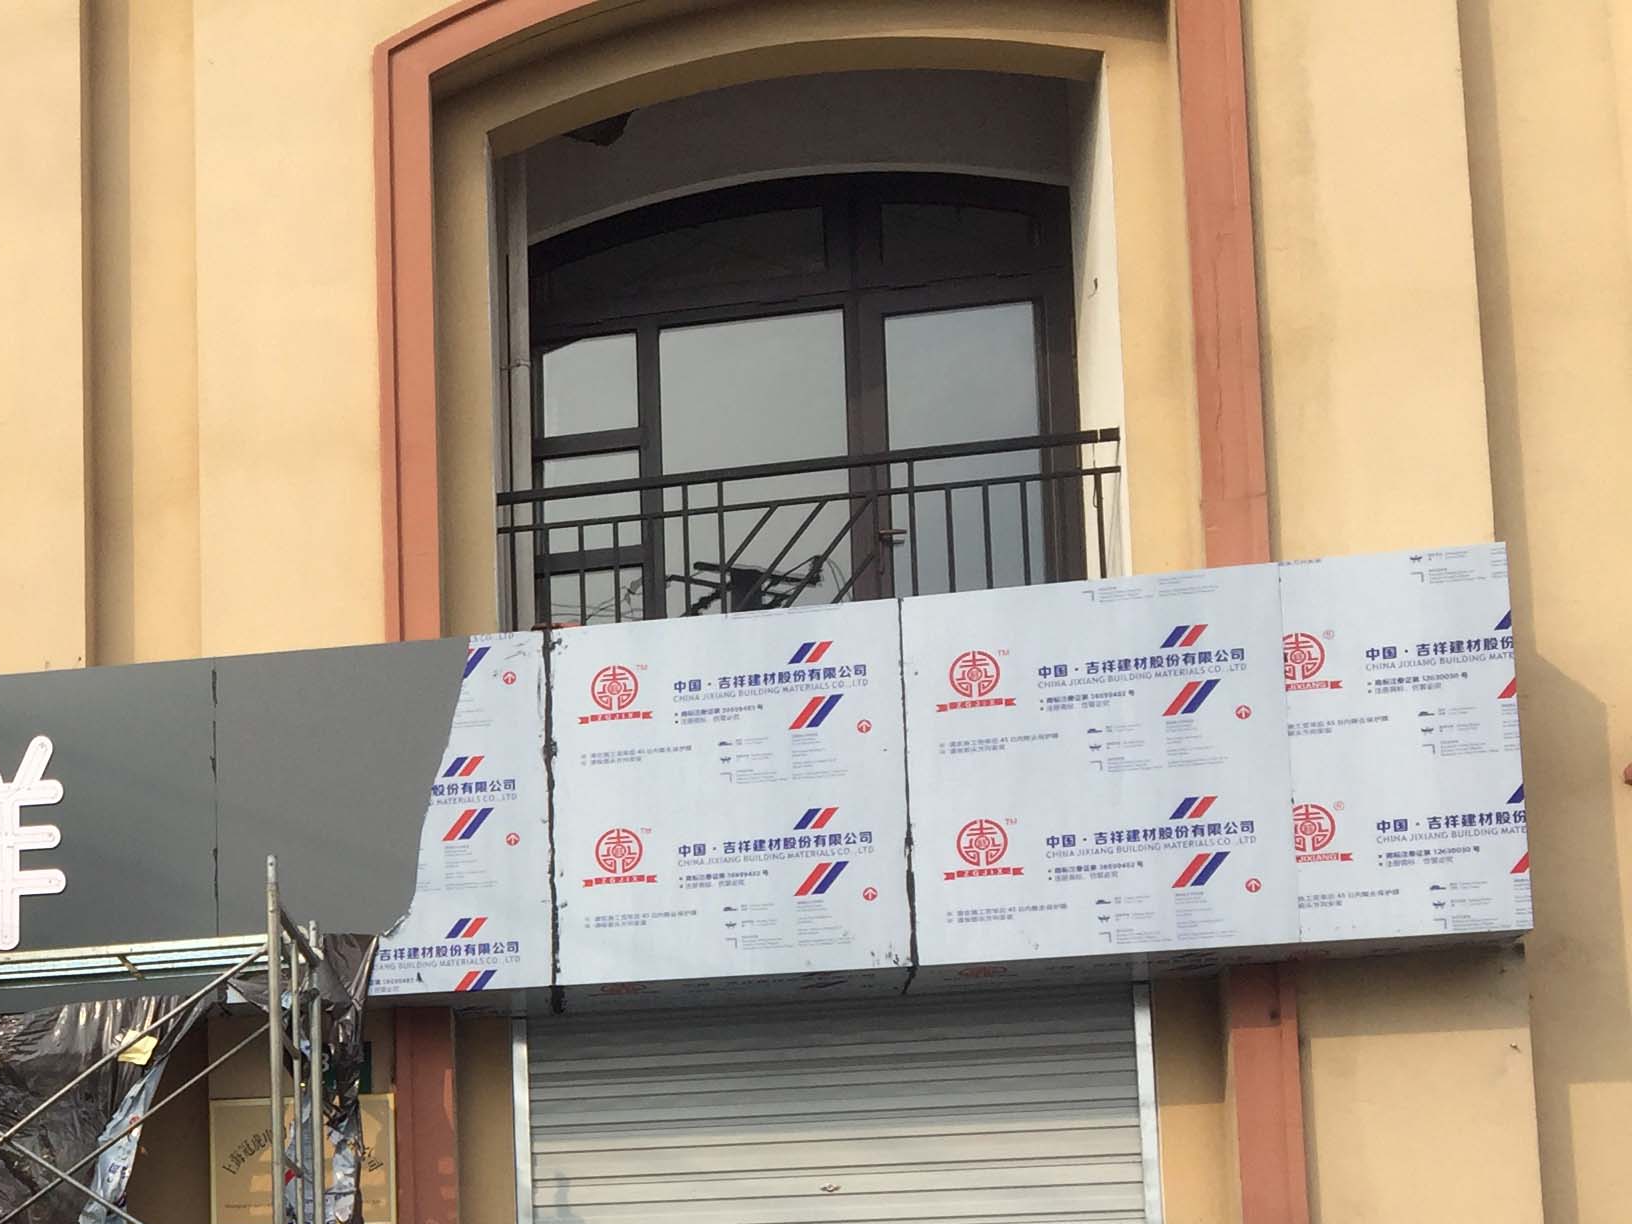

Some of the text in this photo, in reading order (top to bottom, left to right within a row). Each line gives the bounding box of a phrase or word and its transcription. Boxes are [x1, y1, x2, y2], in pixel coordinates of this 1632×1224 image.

[1365, 662, 1396, 671] CHINA
[1398, 658, 1436, 669] JIXIANG
[1439, 654, 1486, 665] BUILDING
[1038, 679, 1067, 689] CHINA
[1069, 675, 1105, 687] JIXIANG
[1108, 671, 1152, 683] BUILDING
[1155, 667, 1205, 678] MATERIALS
[738, 687, 780, 697] BUILDING
[782, 682, 829, 694] MATERIALS
[1376, 835, 1407, 844] CHINA
[1410, 831, 1448, 842] JIXIANG
[1451, 827, 1498, 839] BUILDING
[743, 851, 785, 863] BUILDING
[788, 848, 835, 860] MATERIALS
[1046, 850, 1075, 859] CHINA
[1076, 846, 1114, 857] JIXIANG
[1116, 843, 1161, 854] BUILDING
[1163, 839, 1215, 850] MATERIALS
